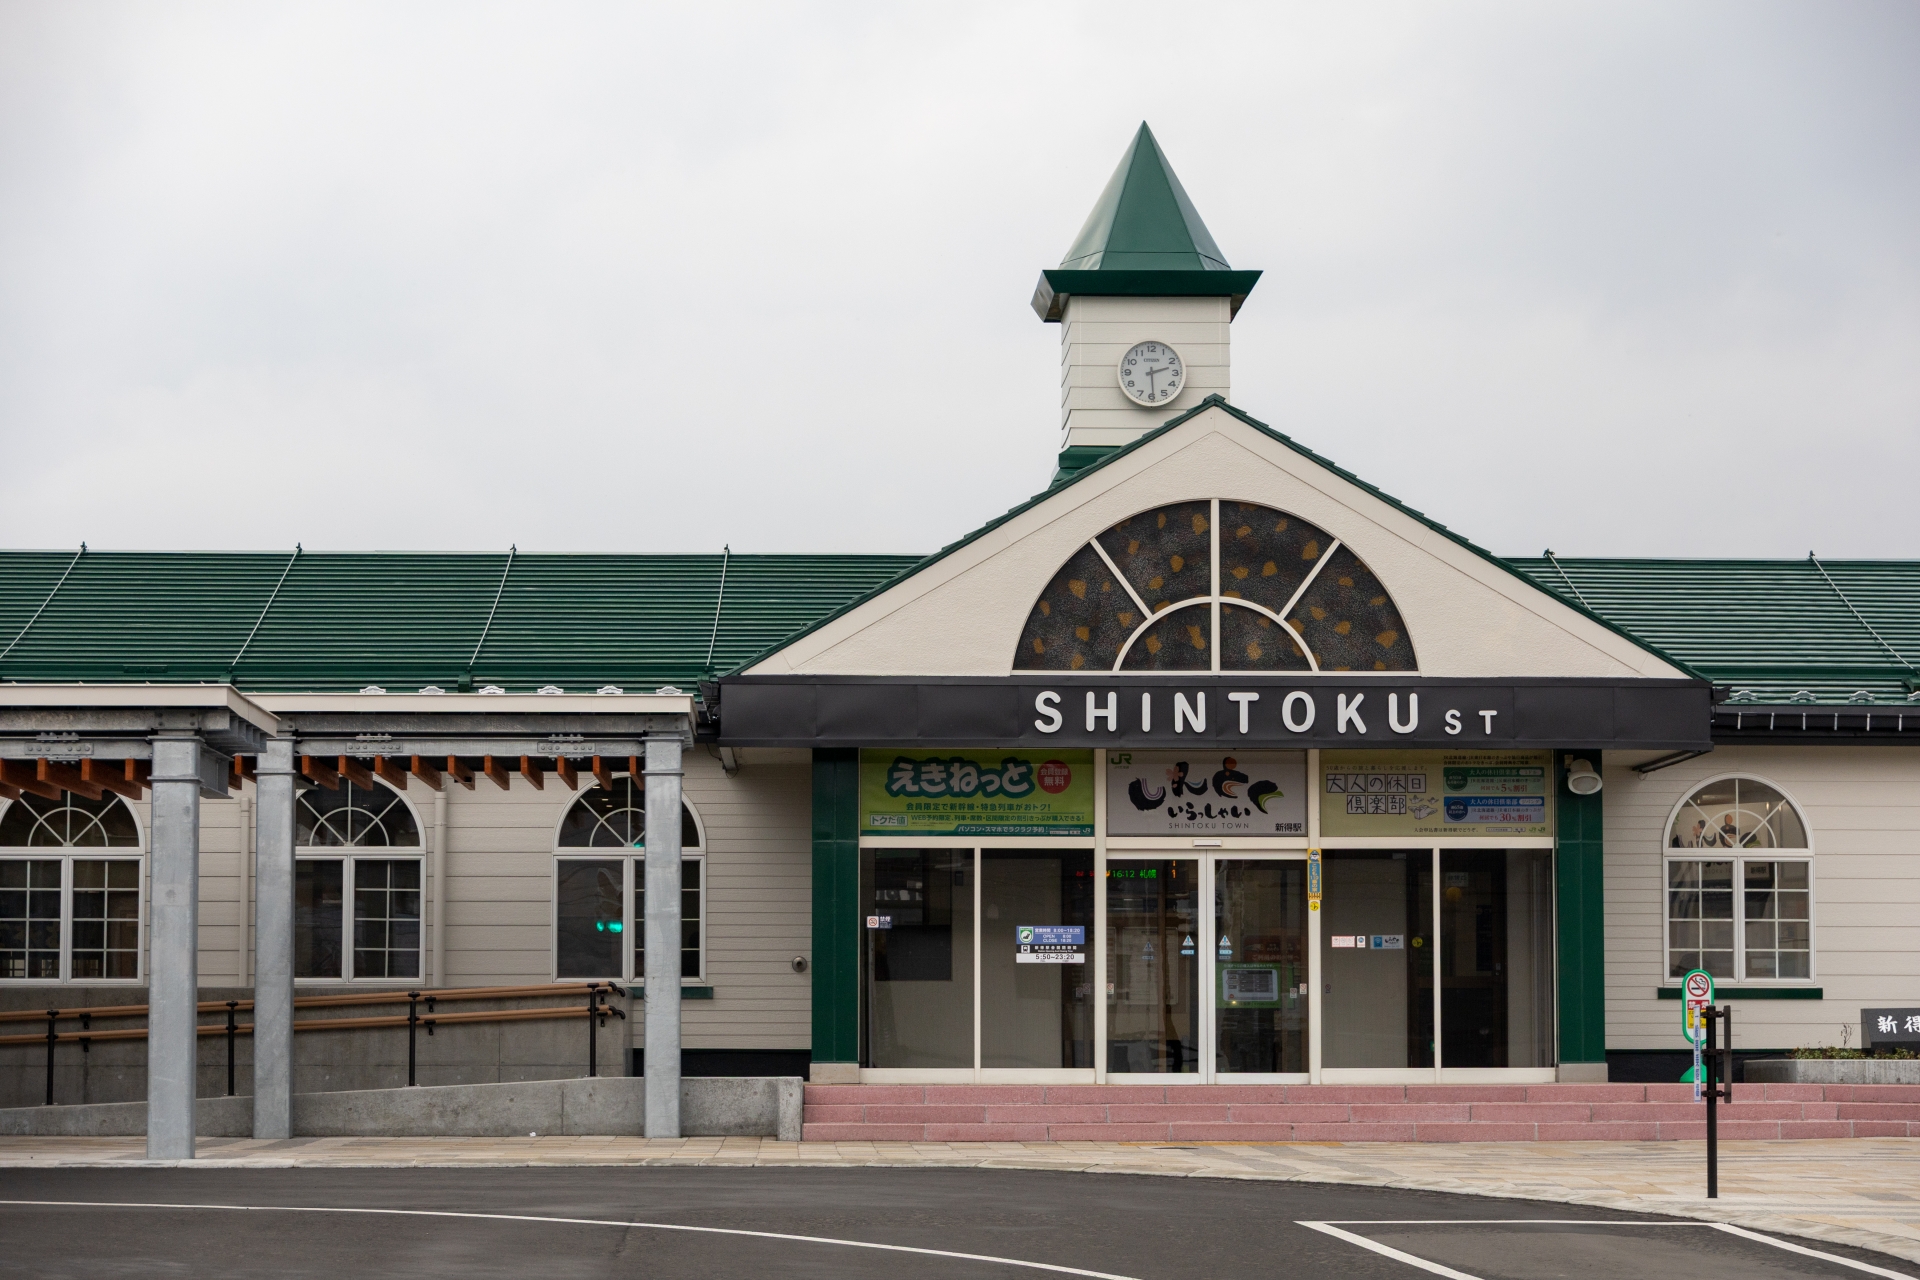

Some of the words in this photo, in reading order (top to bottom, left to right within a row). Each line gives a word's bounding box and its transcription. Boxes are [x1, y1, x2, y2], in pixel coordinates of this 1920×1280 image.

[1135, 349, 1144, 357] 11
[1147, 345, 1157, 353] 12
[1034, 690, 1419, 735] SHINTOKU
[1444, 708, 1498, 736] ST
[1110, 753, 1132, 765] JR
[1040, 767, 1069, 776] 会員登録
[891, 762, 1030, 794] えきねっと
[1043, 776, 1065, 787] 無料
[1327, 773, 1421, 793] 大人の休日
[906, 802, 1051, 812] 会員限定で新幹線・特急列車がおトク!
[1347, 795, 1405, 816] 倶楽部
[1168, 802, 1251, 821] いらっしゃい
[958, 826, 1049, 834] パソコン・スマホでラクラク予約!
[1274, 822, 1303, 833] 新得駅
[1112, 869, 1135, 879] 16:12
[1139, 869, 1157, 879] 札幌
